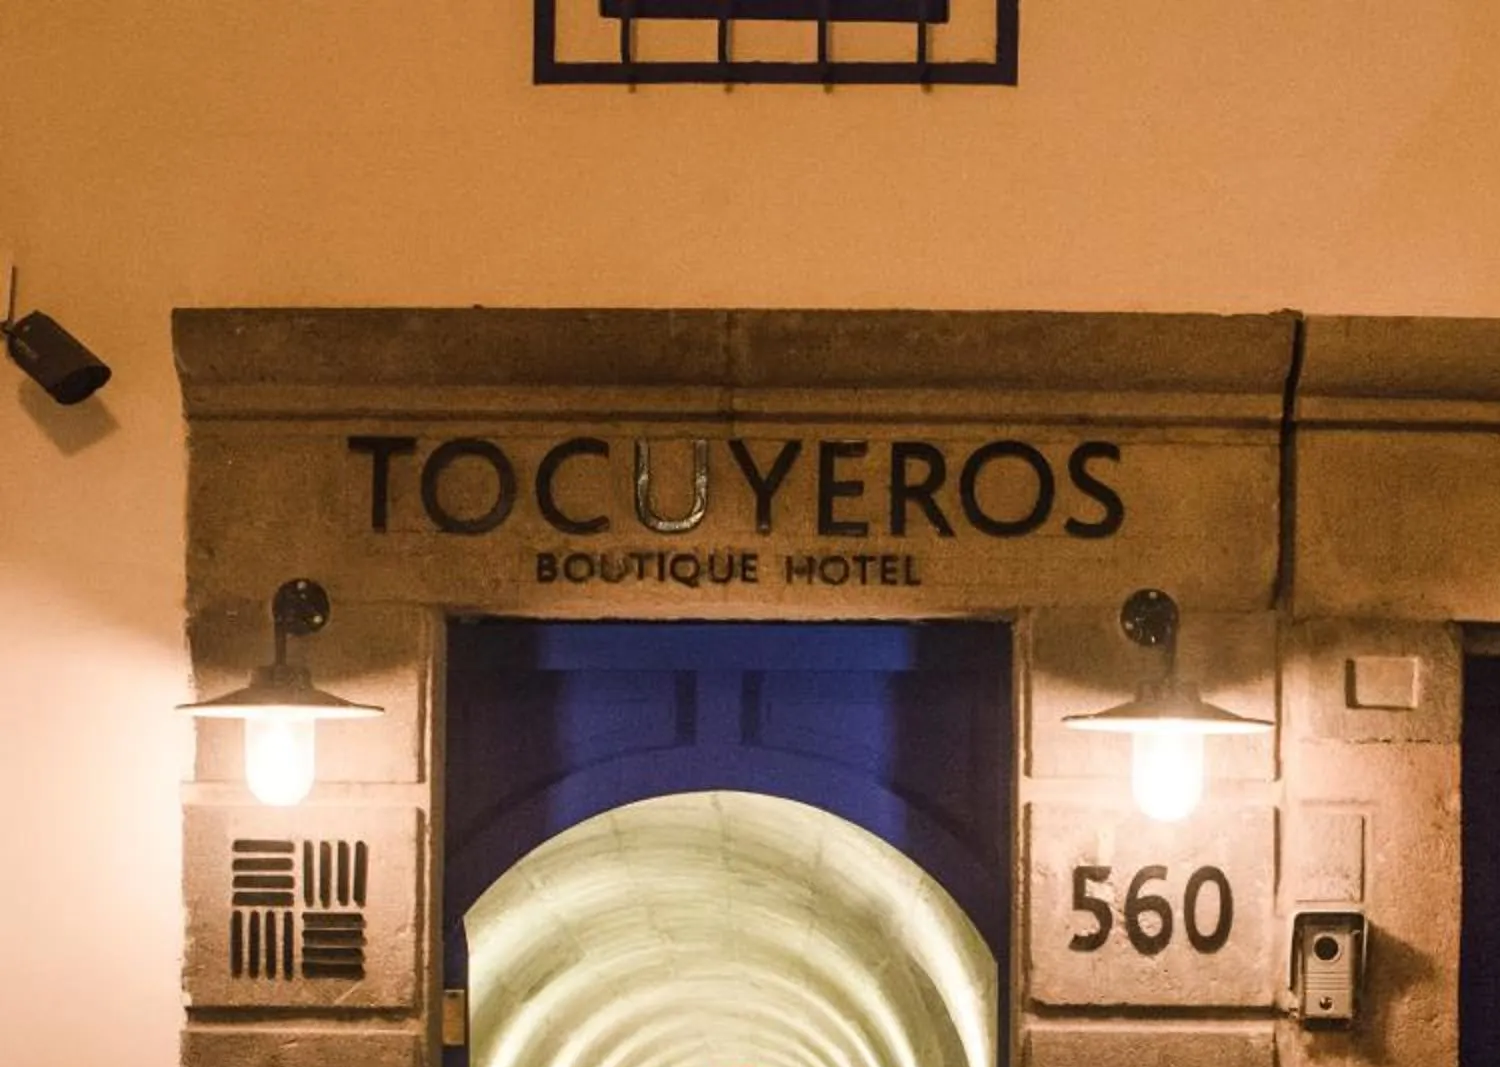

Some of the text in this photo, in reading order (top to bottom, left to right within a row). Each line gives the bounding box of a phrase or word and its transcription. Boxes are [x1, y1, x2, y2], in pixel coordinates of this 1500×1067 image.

[347, 436, 1126, 538] TOCUYEROS
[536, 551, 922, 588] BOUTIQUE HOTEL
[1068, 864, 1234, 955] 560
